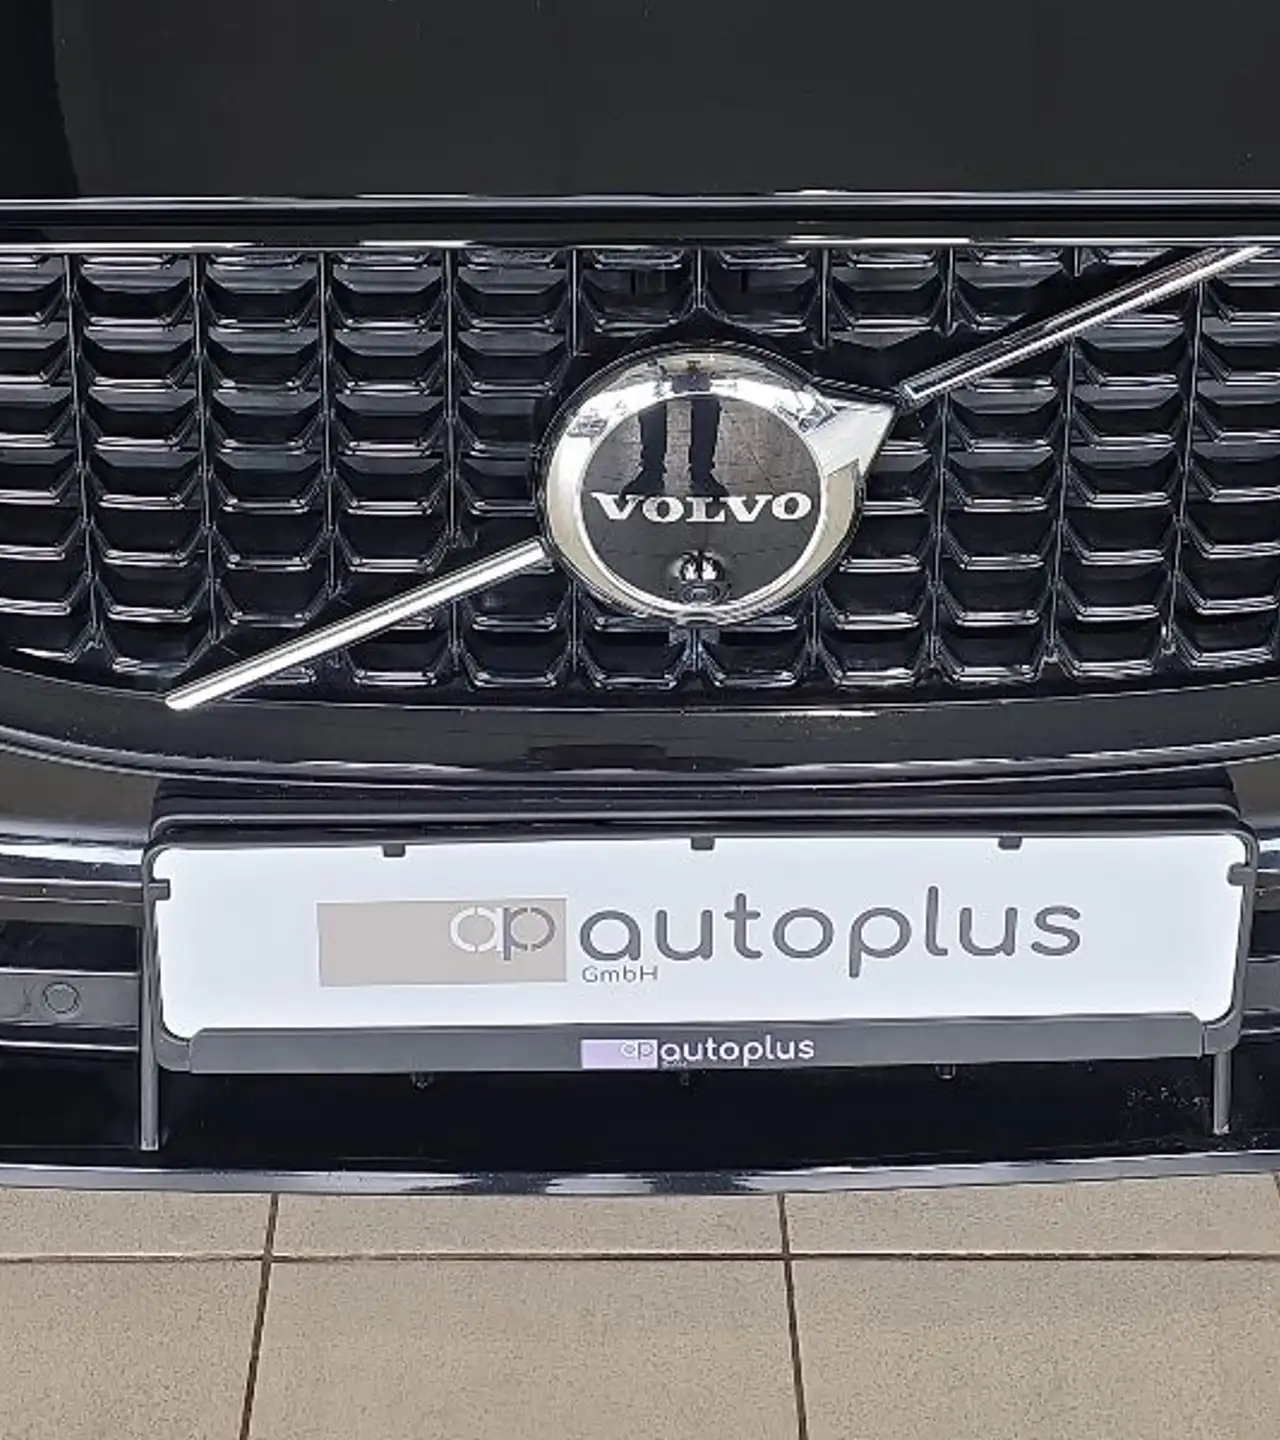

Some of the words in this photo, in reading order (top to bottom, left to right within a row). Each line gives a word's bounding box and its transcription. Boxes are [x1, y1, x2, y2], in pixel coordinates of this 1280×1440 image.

[591, 491, 813, 524] VOLVO
[578, 884, 1082, 979] autoplus
[581, 965, 658, 984] GmbH
[659, 1034, 816, 1067] autoplus
